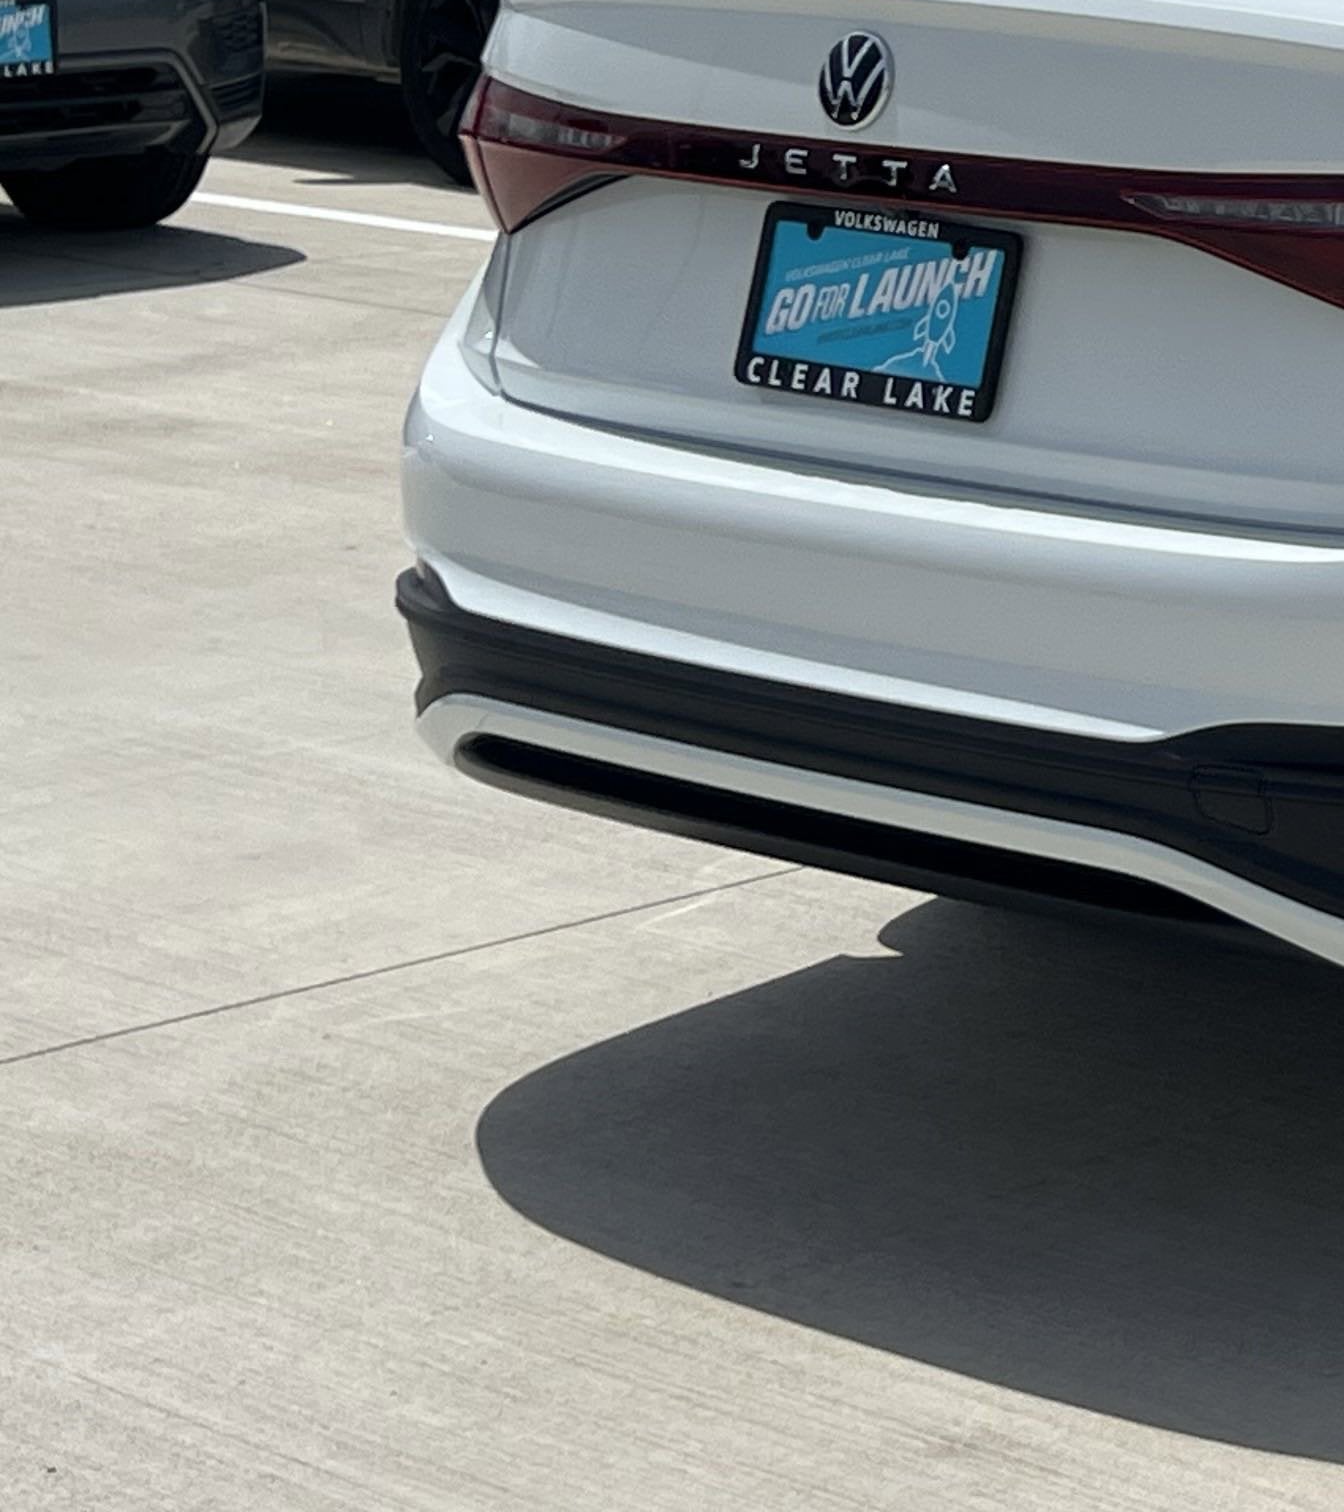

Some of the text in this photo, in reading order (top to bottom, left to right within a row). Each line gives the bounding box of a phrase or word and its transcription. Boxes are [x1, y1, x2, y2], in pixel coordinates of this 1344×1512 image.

[4, 62, 54, 78] LAKE
[739, 143, 958, 194] JETTA
[834, 209, 940, 240] VOLKSWAGEN
[766, 284, 816, 336] GO
[811, 283, 851, 323] FOR
[848, 249, 998, 320] LAUNCH
[747, 356, 977, 417] CLEAR LAKE
